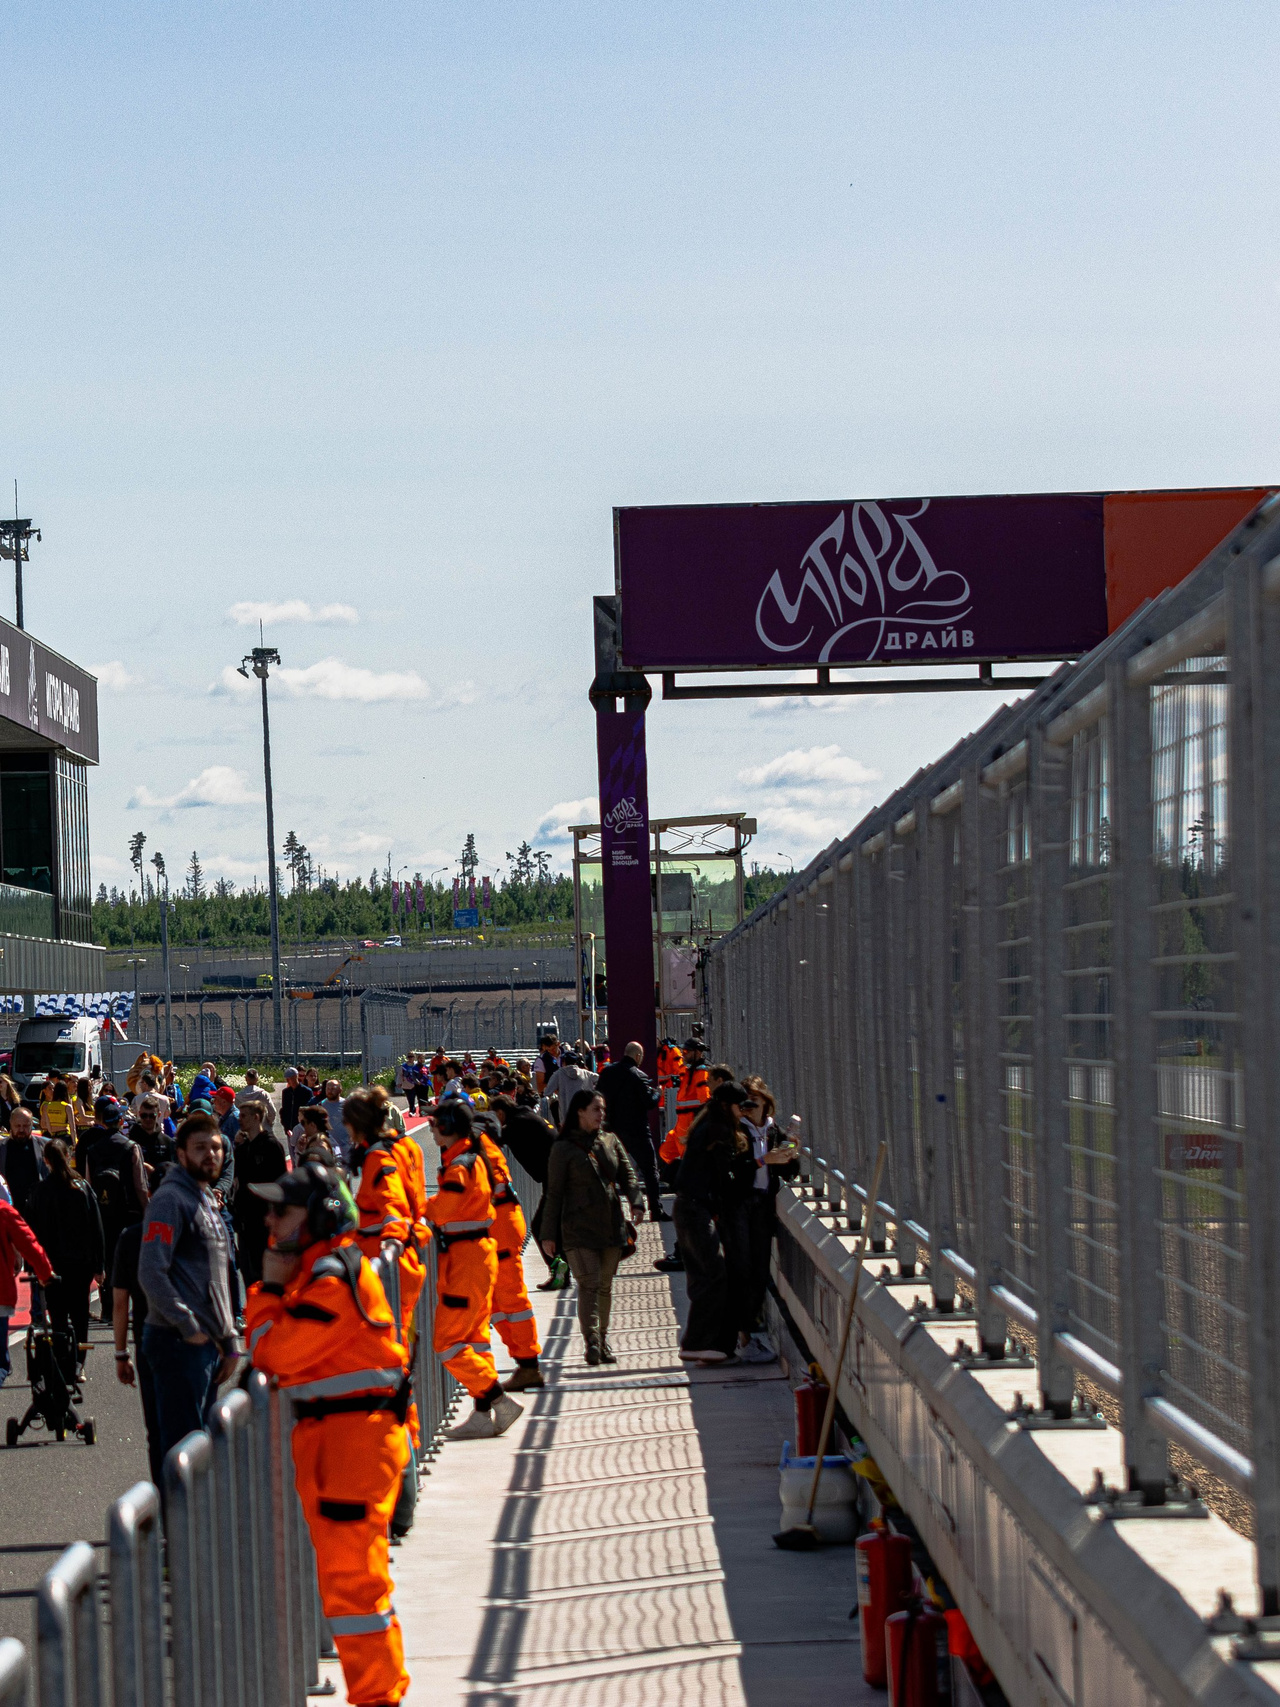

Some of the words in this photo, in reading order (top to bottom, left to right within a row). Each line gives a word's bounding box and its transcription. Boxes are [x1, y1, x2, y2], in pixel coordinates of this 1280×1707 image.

[884, 627, 975, 650] ДРАЙВ
[611, 859, 639, 867] ЭМОЦИЙ
[143, 1221, 175, 1246] JPN
